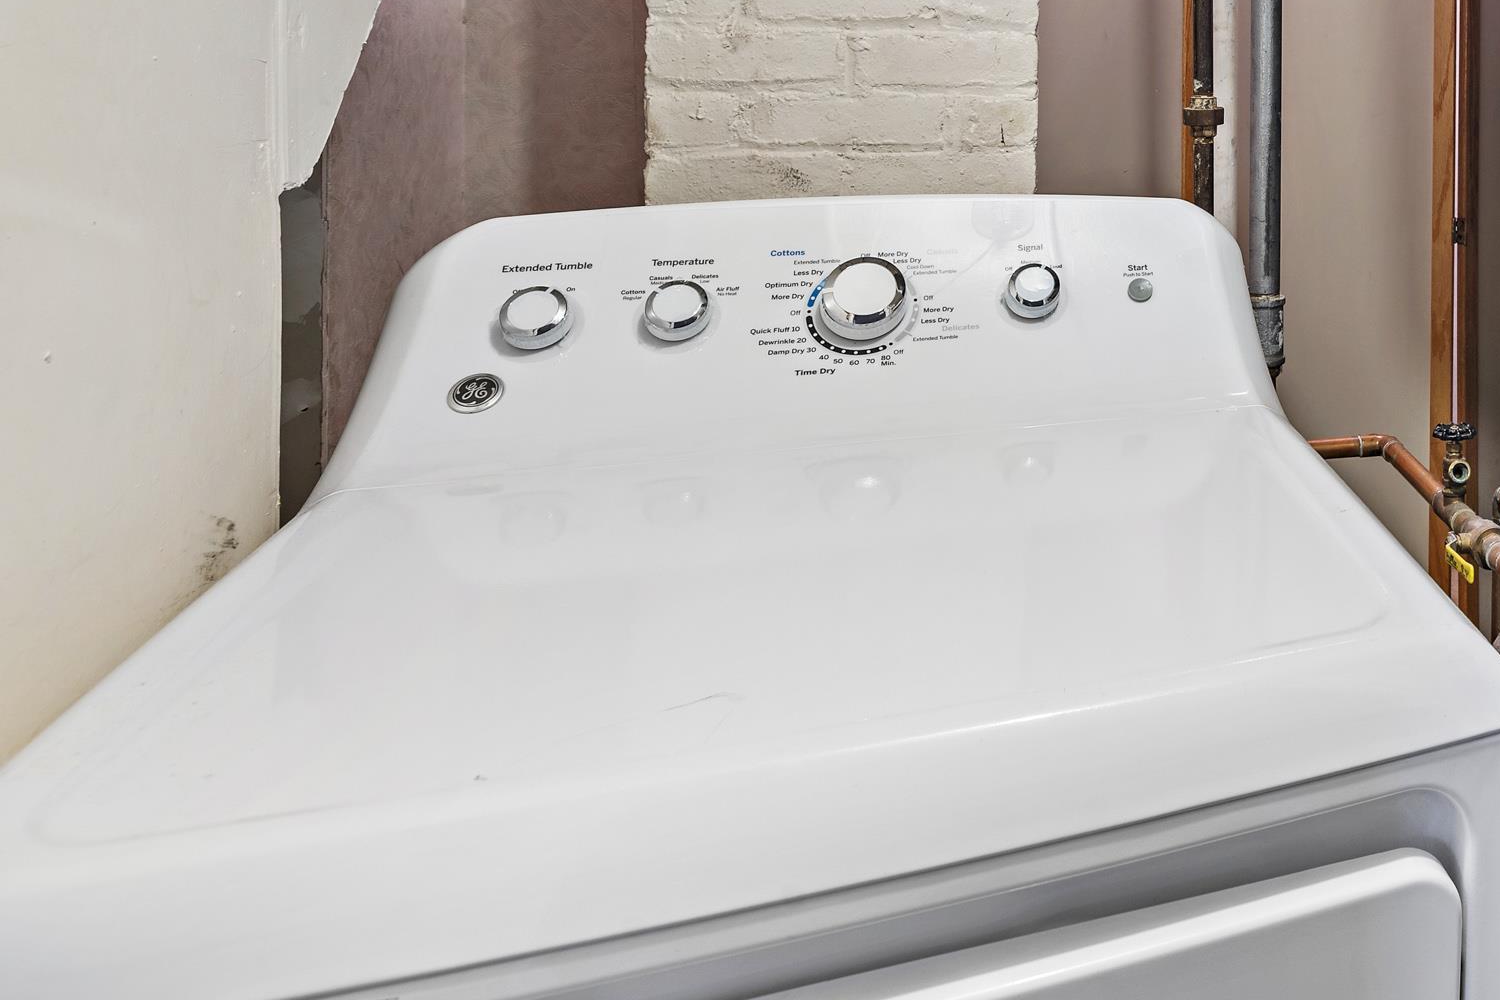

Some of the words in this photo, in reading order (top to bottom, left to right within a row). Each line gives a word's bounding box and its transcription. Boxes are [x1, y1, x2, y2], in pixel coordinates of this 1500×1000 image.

[1017, 243, 1043, 252] Signal
[770, 249, 806, 257] Cottons
[652, 258, 714, 267] Temperature
[501, 263, 552, 273] Extended
[555, 262, 593, 271] Tumble
[941, 324, 980, 332] Delicates
[758, 338, 795, 346] Dewrinkle
[819, 367, 836, 375] Dry
